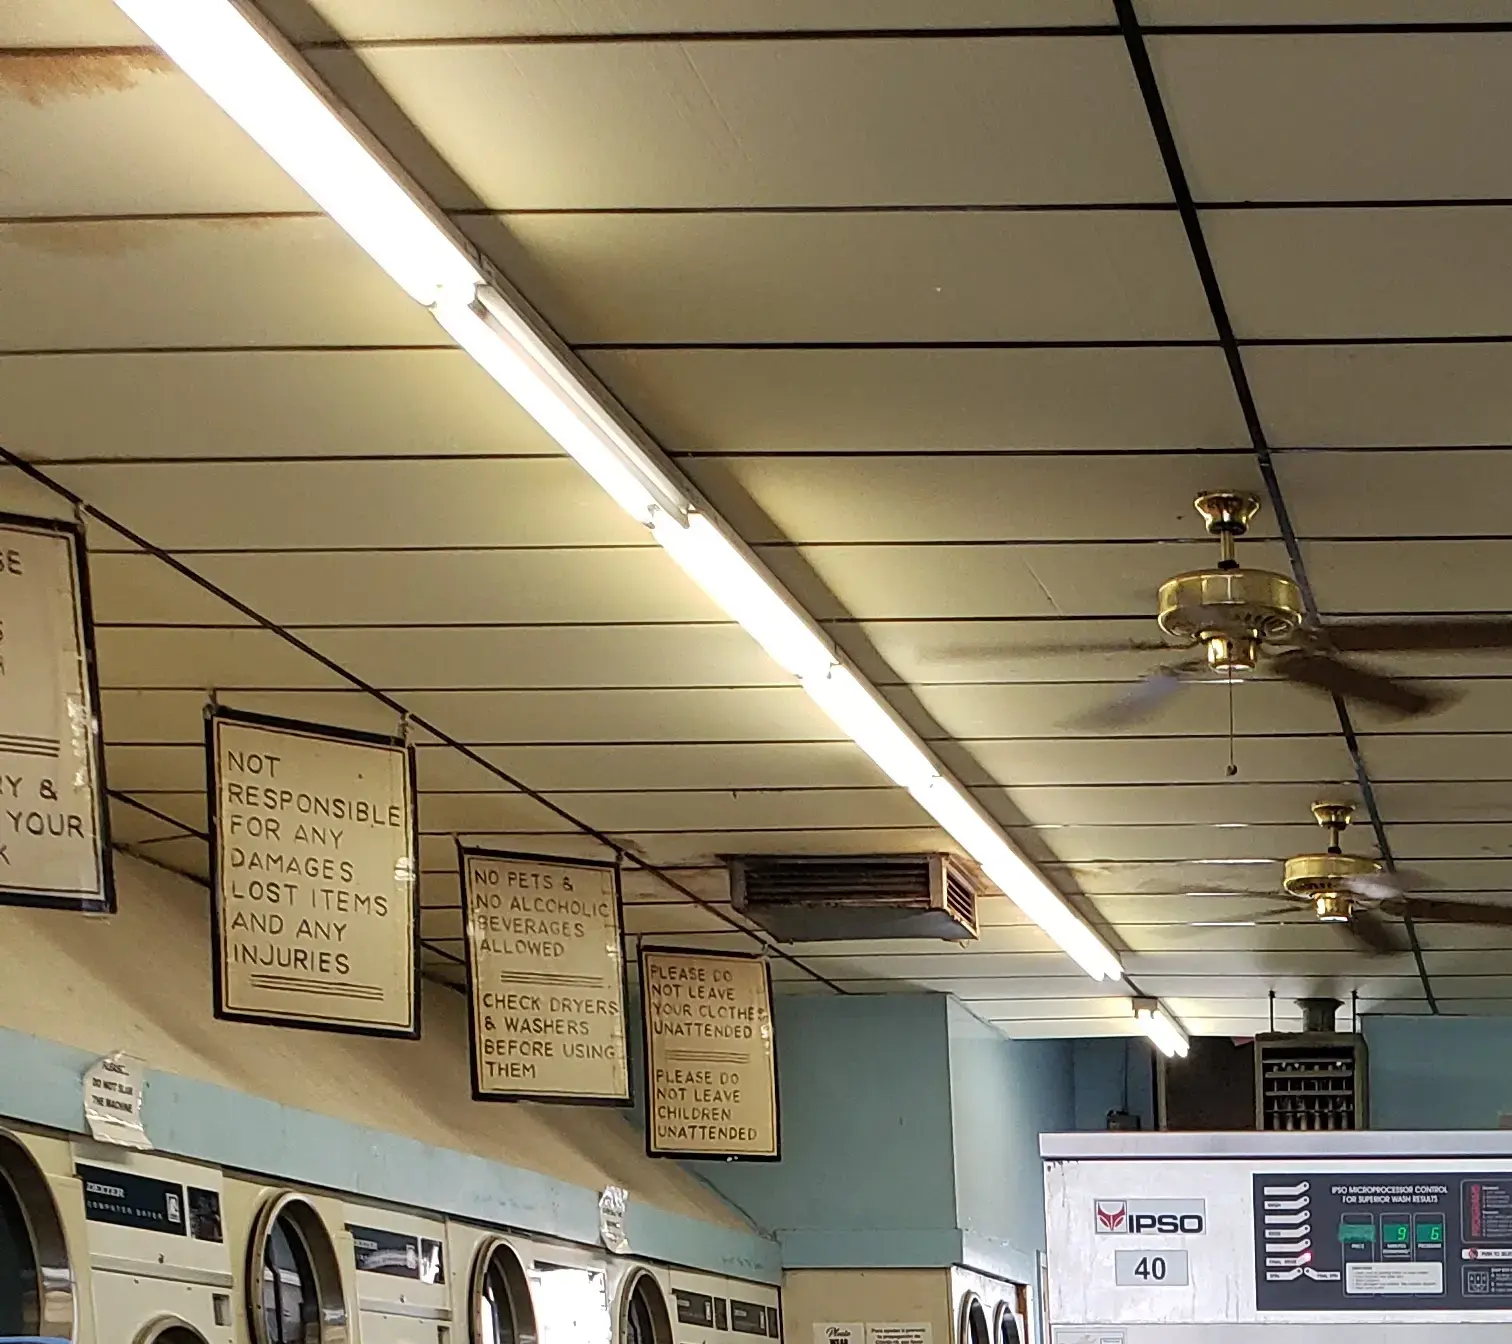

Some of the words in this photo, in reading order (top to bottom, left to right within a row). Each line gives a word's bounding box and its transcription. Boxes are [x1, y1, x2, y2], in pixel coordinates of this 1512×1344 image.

[228, 751, 280, 777] NOT
[40, 779, 57, 800] &
[228, 783, 400, 827] RESPONSIBLE
[6, 809, 84, 838] YOUR
[231, 815, 280, 841] FOR
[294, 824, 343, 849] ANY
[231, 848, 353, 882] DAMAGES
[475, 869, 499, 885] NO
[508, 872, 553, 891] PETS
[563, 877, 574, 892] &
[232, 880, 298, 905] LOST
[312, 889, 387, 917] ITEMS
[476, 894, 500, 909] NO
[510, 897, 610, 918] ALCOHOLIC
[232, 912, 283, 934] AND
[296, 919, 347, 941] ANY
[477, 915, 585, 938] BEVERAGES
[234, 944, 349, 974] INJURIES
[480, 940, 565, 958] ALLOWED
[650, 965, 705, 982] PLEASE
[713, 969, 733, 982] DO
[652, 984, 682, 999] NOT
[689, 986, 735, 1001] LEAVE
[483, 993, 541, 1011] CHECK
[550, 997, 620, 1015] DRYERS
[653, 1003, 692, 1019] YOUR
[485, 1017, 496, 1030] &
[505, 1017, 589, 1035] WASHERS
[654, 1021, 752, 1039] UNATTENDED
[484, 1039, 554, 1057] BEFORE
[563, 1043, 615, 1060] USING
[487, 1061, 536, 1079] THEM
[656, 1069, 713, 1085] PLEASE
[720, 1072, 740, 1086] DO
[657, 1087, 687, 1102] NOT
[694, 1088, 741, 1103] LEAVE
[658, 1105, 732, 1121] CHILDREN
[658, 1124, 757, 1141] UNATTENDED
[1392, 1195, 1411, 1203] WASH
[1415, 1186, 1448, 1194] CONTROL
[1128, 1213, 1203, 1234] IPSO
[1134, 1257, 1166, 1281] 40
